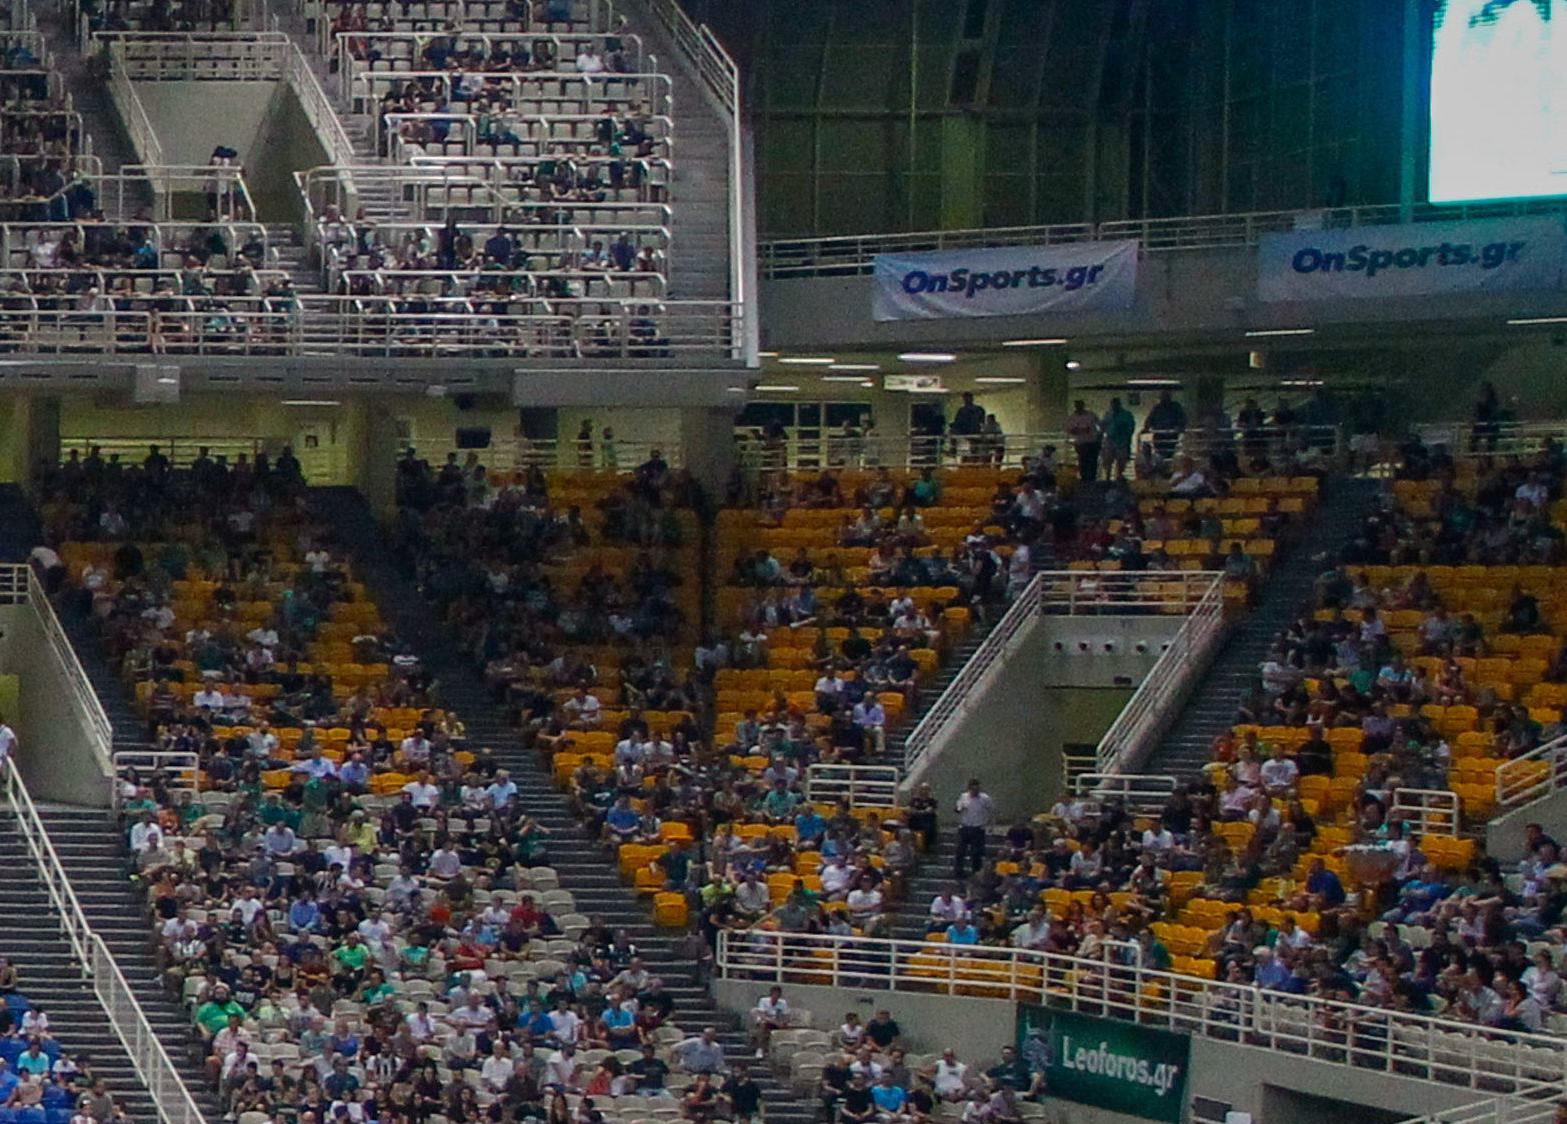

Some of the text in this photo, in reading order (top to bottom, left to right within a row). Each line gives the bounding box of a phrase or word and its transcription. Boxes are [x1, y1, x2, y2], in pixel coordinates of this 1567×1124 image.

[1291, 235, 1527, 276] OnSports.gr
[901, 261, 1105, 299] OnSports.gr
[1061, 1034, 1179, 1097] Leoforos.gr
